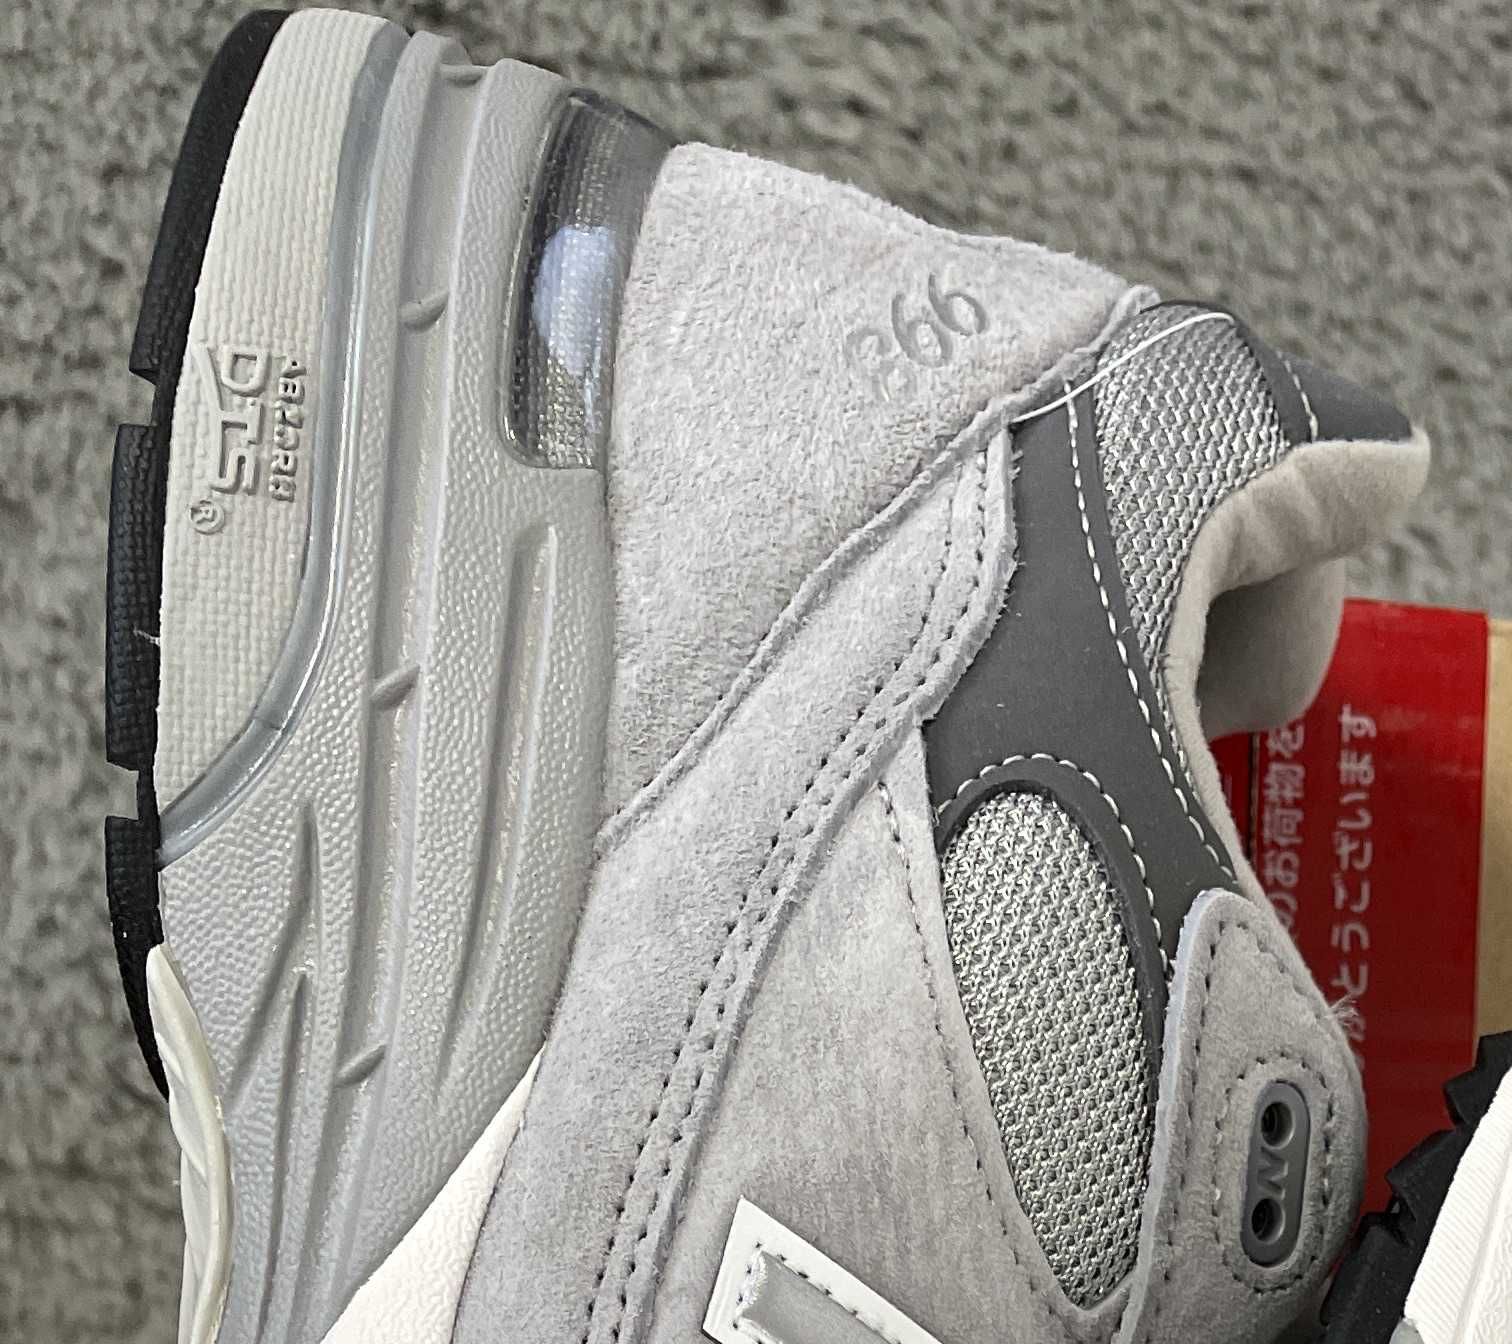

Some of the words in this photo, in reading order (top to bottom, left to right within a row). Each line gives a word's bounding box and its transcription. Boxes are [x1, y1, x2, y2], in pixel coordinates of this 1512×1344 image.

[211, 345, 270, 495] DTS
[1262, 722, 1306, 936] のお荷物を
